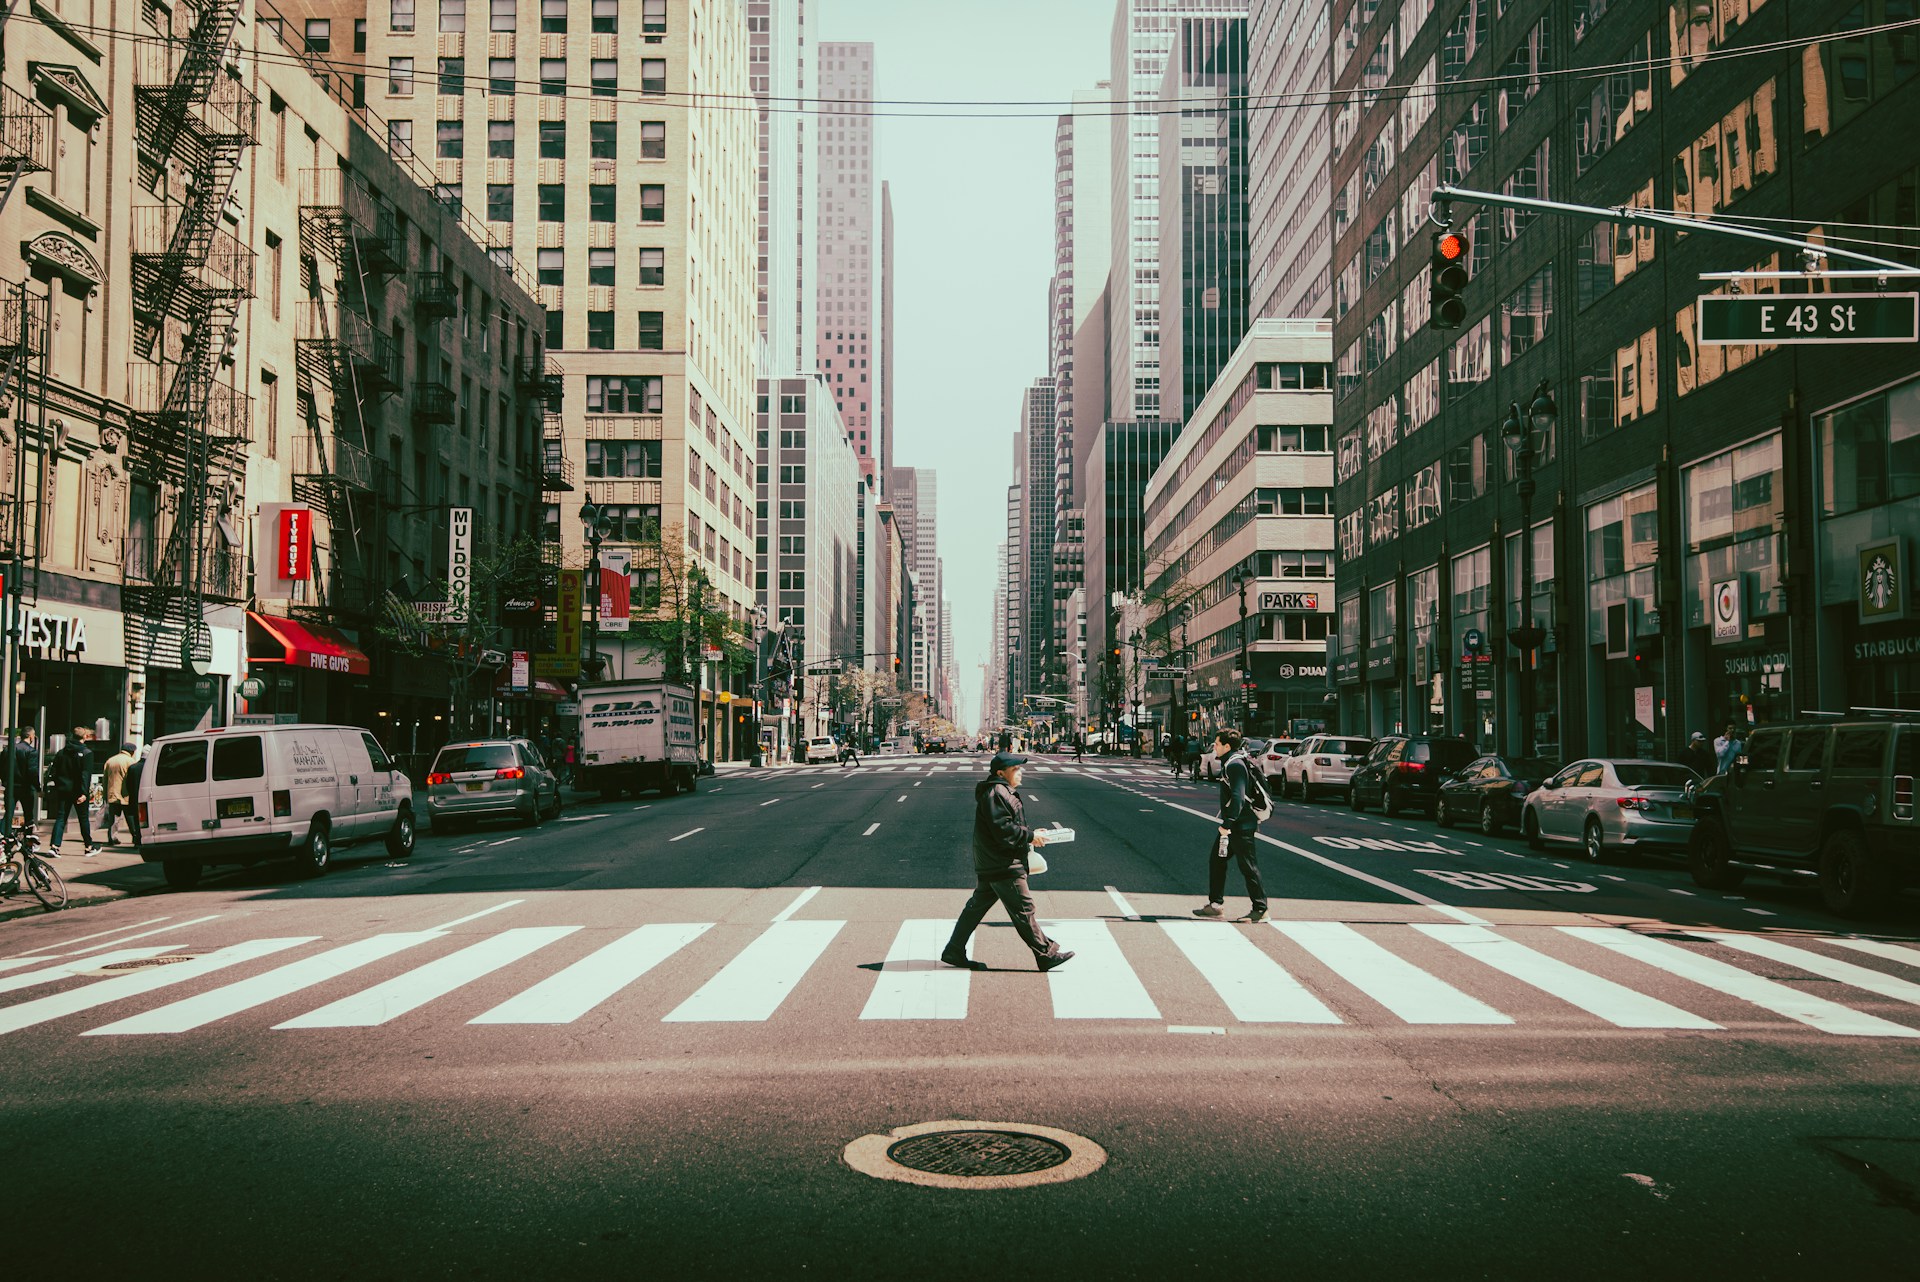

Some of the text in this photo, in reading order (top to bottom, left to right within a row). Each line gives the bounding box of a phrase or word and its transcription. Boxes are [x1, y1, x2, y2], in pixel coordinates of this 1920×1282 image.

[1761, 305, 1855, 333] E 43 St
[288, 513, 299, 575] FIVE GUYS
[417, 603, 446, 612] IRISH
[1264, 595, 1303, 608] PARK
[562, 573, 578, 654] DELI
[1717, 625, 1737, 636] bento
[310, 652, 350, 673] FIVE GUYS
[1725, 657, 1750, 675] SUSHI
[1751, 656, 1758, 672] &
[243, 681, 259, 690] NAYA
[293, 755, 327, 766] MANHATTAN
[1311, 836, 1466, 856] ONLY
[1414, 868, 1598, 893] BUS
